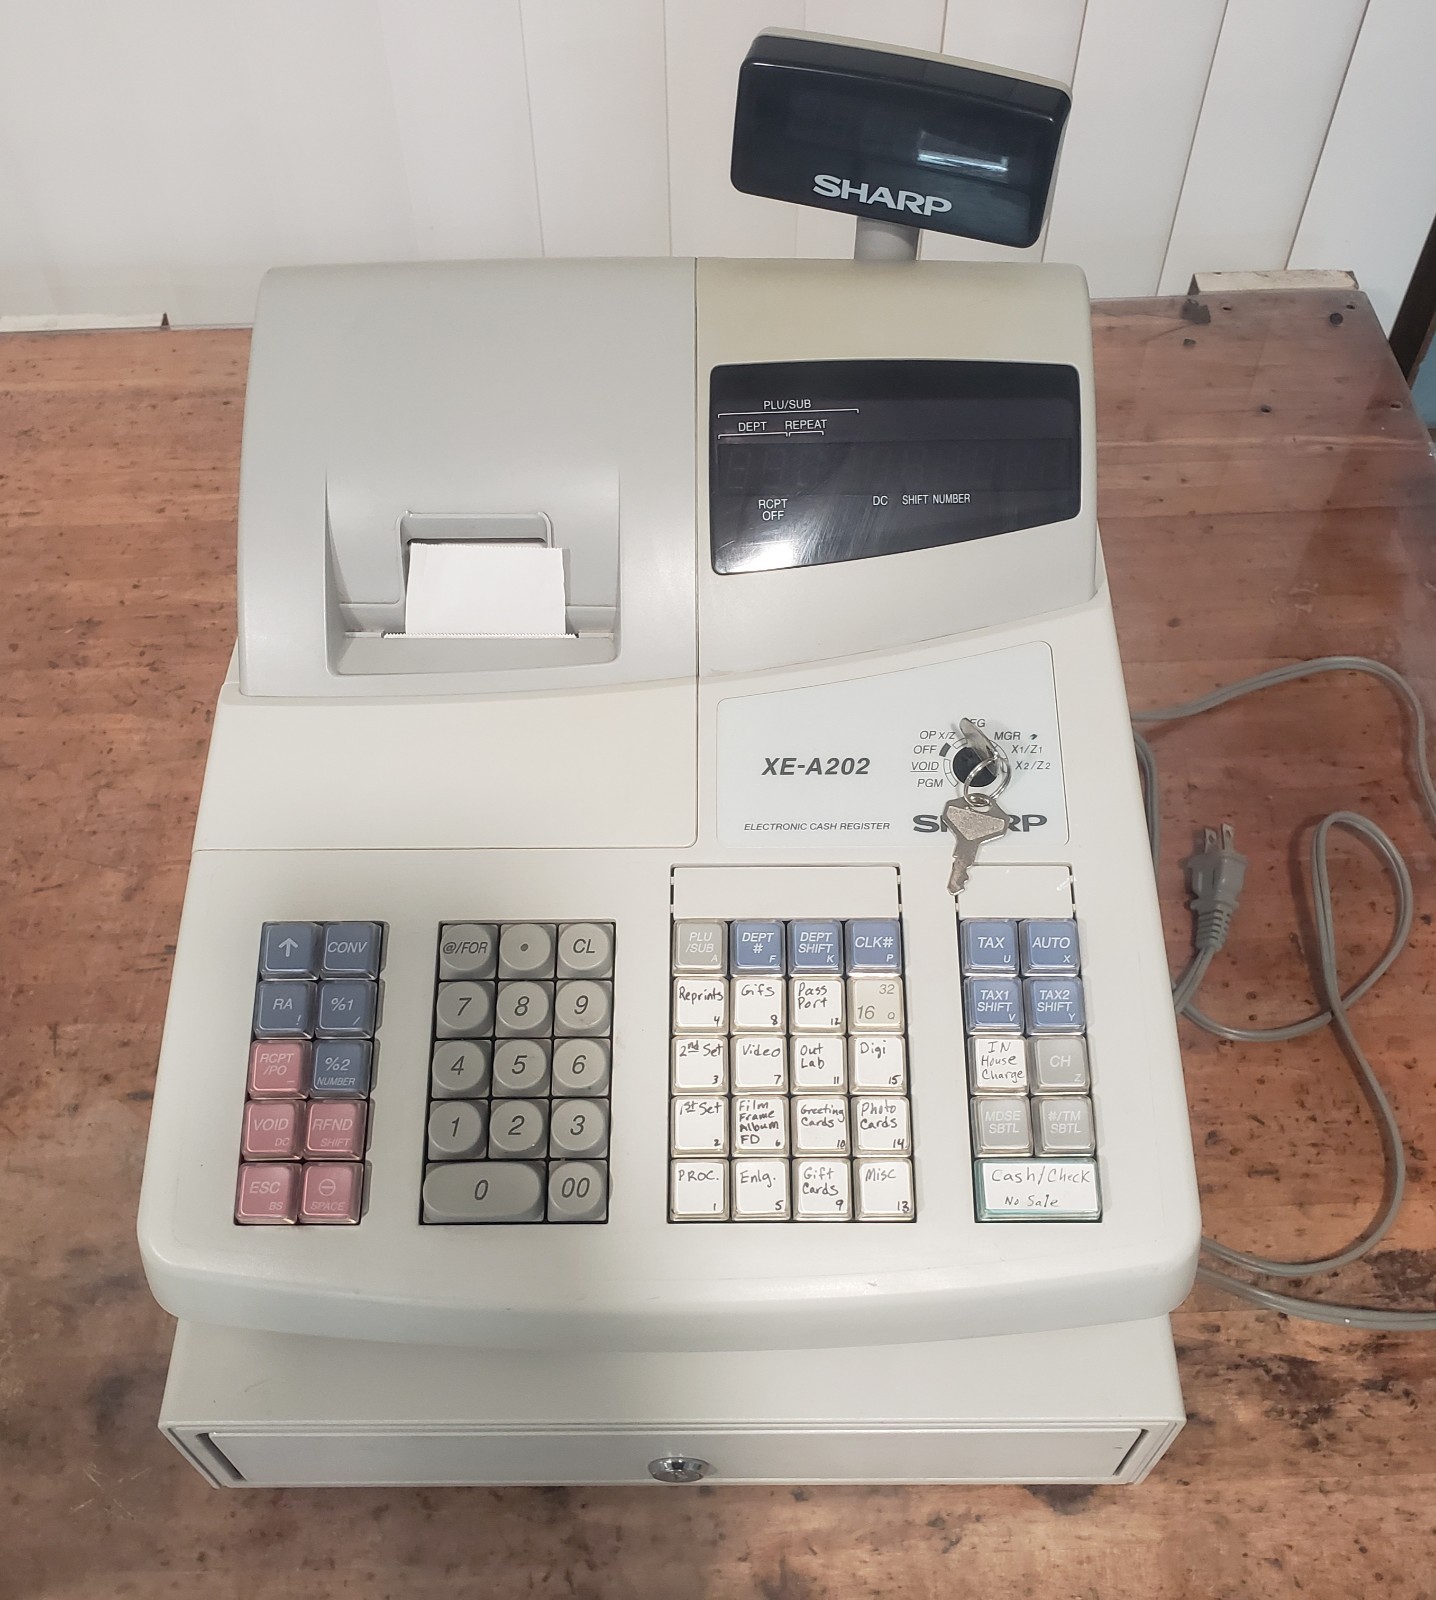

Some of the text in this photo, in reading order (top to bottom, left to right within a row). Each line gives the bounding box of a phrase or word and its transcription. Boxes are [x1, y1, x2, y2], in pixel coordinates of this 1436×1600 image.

[812, 174, 952, 216] SHARP
[763, 399, 812, 410] PLU/SUB
[738, 421, 767, 432] DEPT
[785, 419, 827, 430] REPEAT
[758, 499, 788, 509] RCPT
[872, 495, 888, 506] DC
[902, 493, 971, 505] SHIFT NUMBER
[762, 510, 784, 521] OFF
[919, 730, 956, 740] OP X/Z
[993, 731, 1021, 741] MGR
[913, 744, 937, 755] OFF
[1011, 744, 1043, 754] X1/Z1
[761, 757, 871, 776] XE-A202
[910, 761, 939, 772] VOID
[1015, 760, 1051, 770] X2/Z2
[917, 778, 943, 788] PGM
[743, 822, 891, 831] ELECTRONIC CASH REGISTER
[912, 813, 1048, 833] SRP
[689, 932, 712, 942] PLU
[742, 932, 774, 942] DEPT
[800, 932, 832, 942] DEPT
[855, 936, 893, 948] CLK#
[327, 941, 368, 954] CONV
[442, 941, 488, 954] @/FOR
[572, 938, 595, 954] CL
[685, 943, 714, 953] /SUB
[798, 943, 833, 953] SHIFT
[977, 937, 1006, 949] TAX
[1032, 937, 1071, 949] AUTO
[710, 954, 718, 962] A
[769, 955, 776, 963] F
[826, 955, 835, 963] K
[886, 954, 894, 962] P
[1003, 954, 1011, 963] U
[1063, 955, 1071, 963] X
[798, 982, 828, 997] Pass
[879, 984, 895, 995] 32
[980, 990, 1009, 1000] TAX1
[1039, 990, 1070, 1000] TAX2
[679, 986, 724, 1005] Reprints
[272, 998, 293, 1010] RA
[331, 996, 354, 1012] %1
[457, 997, 472, 1016] 7
[514, 996, 530, 1017] 8
[574, 995, 589, 1015] 9
[798, 996, 828, 1010] Port
[977, 1002, 1013, 1012] SHIFT
[1036, 1002, 1072, 1012] SHIFT
[857, 1005, 875, 1020] 16
[1008, 1013, 1016, 1022] V
[1068, 1013, 1076, 1022] Y
[713, 1015, 720, 1026] 4
[770, 1014, 778, 1026] 8
[830, 1017, 841, 1026] 12
[679, 1040, 722, 1057] 2nd Set
[742, 1044, 781, 1057] Video
[800, 1042, 824, 1056] Out
[860, 1040, 887, 1059] Digi
[987, 1041, 1011, 1053] IN
[260, 1053, 294, 1063] RCPT
[800, 1057, 825, 1069] Lab
[981, 1055, 1018, 1066] House
[1049, 1056, 1071, 1068] CH
[325, 1056, 350, 1072] %2
[451, 1055, 465, 1076] 4
[511, 1055, 527, 1075] 5
[572, 1054, 587, 1075] 6
[263, 1065, 287, 1076] /PO
[981, 1069, 1024, 1083] Charge
[316, 1077, 355, 1086] NUMBER
[712, 1075, 719, 1085] 3
[773, 1074, 782, 1085] 7
[833, 1076, 840, 1085] 11
[888, 1074, 902, 1085] 15
[1074, 1074, 1081, 1082] Z
[699, 1101, 722, 1116] Set
[739, 1100, 769, 1112] Film
[861, 1099, 897, 1117] Photo
[739, 1110, 775, 1122] Frame
[800, 1104, 845, 1123] Greeting
[985, 1110, 1021, 1121] MDSE
[1048, 1111, 1081, 1121] #/TM
[253, 1118, 289, 1131] VOID
[312, 1118, 353, 1131] RFND
[451, 1117, 460, 1137] 1
[508, 1115, 525, 1136] 2
[570, 1115, 586, 1136] 3
[739, 1121, 779, 1133] Album
[801, 1116, 835, 1129] Cards
[860, 1116, 898, 1130] Cards
[988, 1123, 1019, 1134] SBTL
[1050, 1123, 1082, 1134] SBTL
[275, 1138, 290, 1147] DC
[320, 1138, 351, 1147] SHIFT
[713, 1138, 721, 1147] 2
[740, 1134, 760, 1145] FD
[775, 1139, 781, 1147] 6
[836, 1139, 846, 1149] 10
[892, 1138, 905, 1149] 14
[739, 1169, 776, 1188] Enlg.
[803, 1166, 835, 1180] Gift
[865, 1168, 896, 1182] Misc
[250, 1181, 281, 1194] ESC
[474, 1179, 489, 1201] 0
[561, 1177, 590, 1198] 00
[802, 1182, 839, 1196] Cards
[269, 1202, 283, 1211] BS
[310, 1202, 346, 1211] SPACE
[775, 1200, 784, 1211] 5
[835, 1199, 844, 1211] 9
[1005, 1194, 1059, 1208] No Sale
[713, 1203, 717, 1211] 1
[897, 1201, 910, 1213] 13
